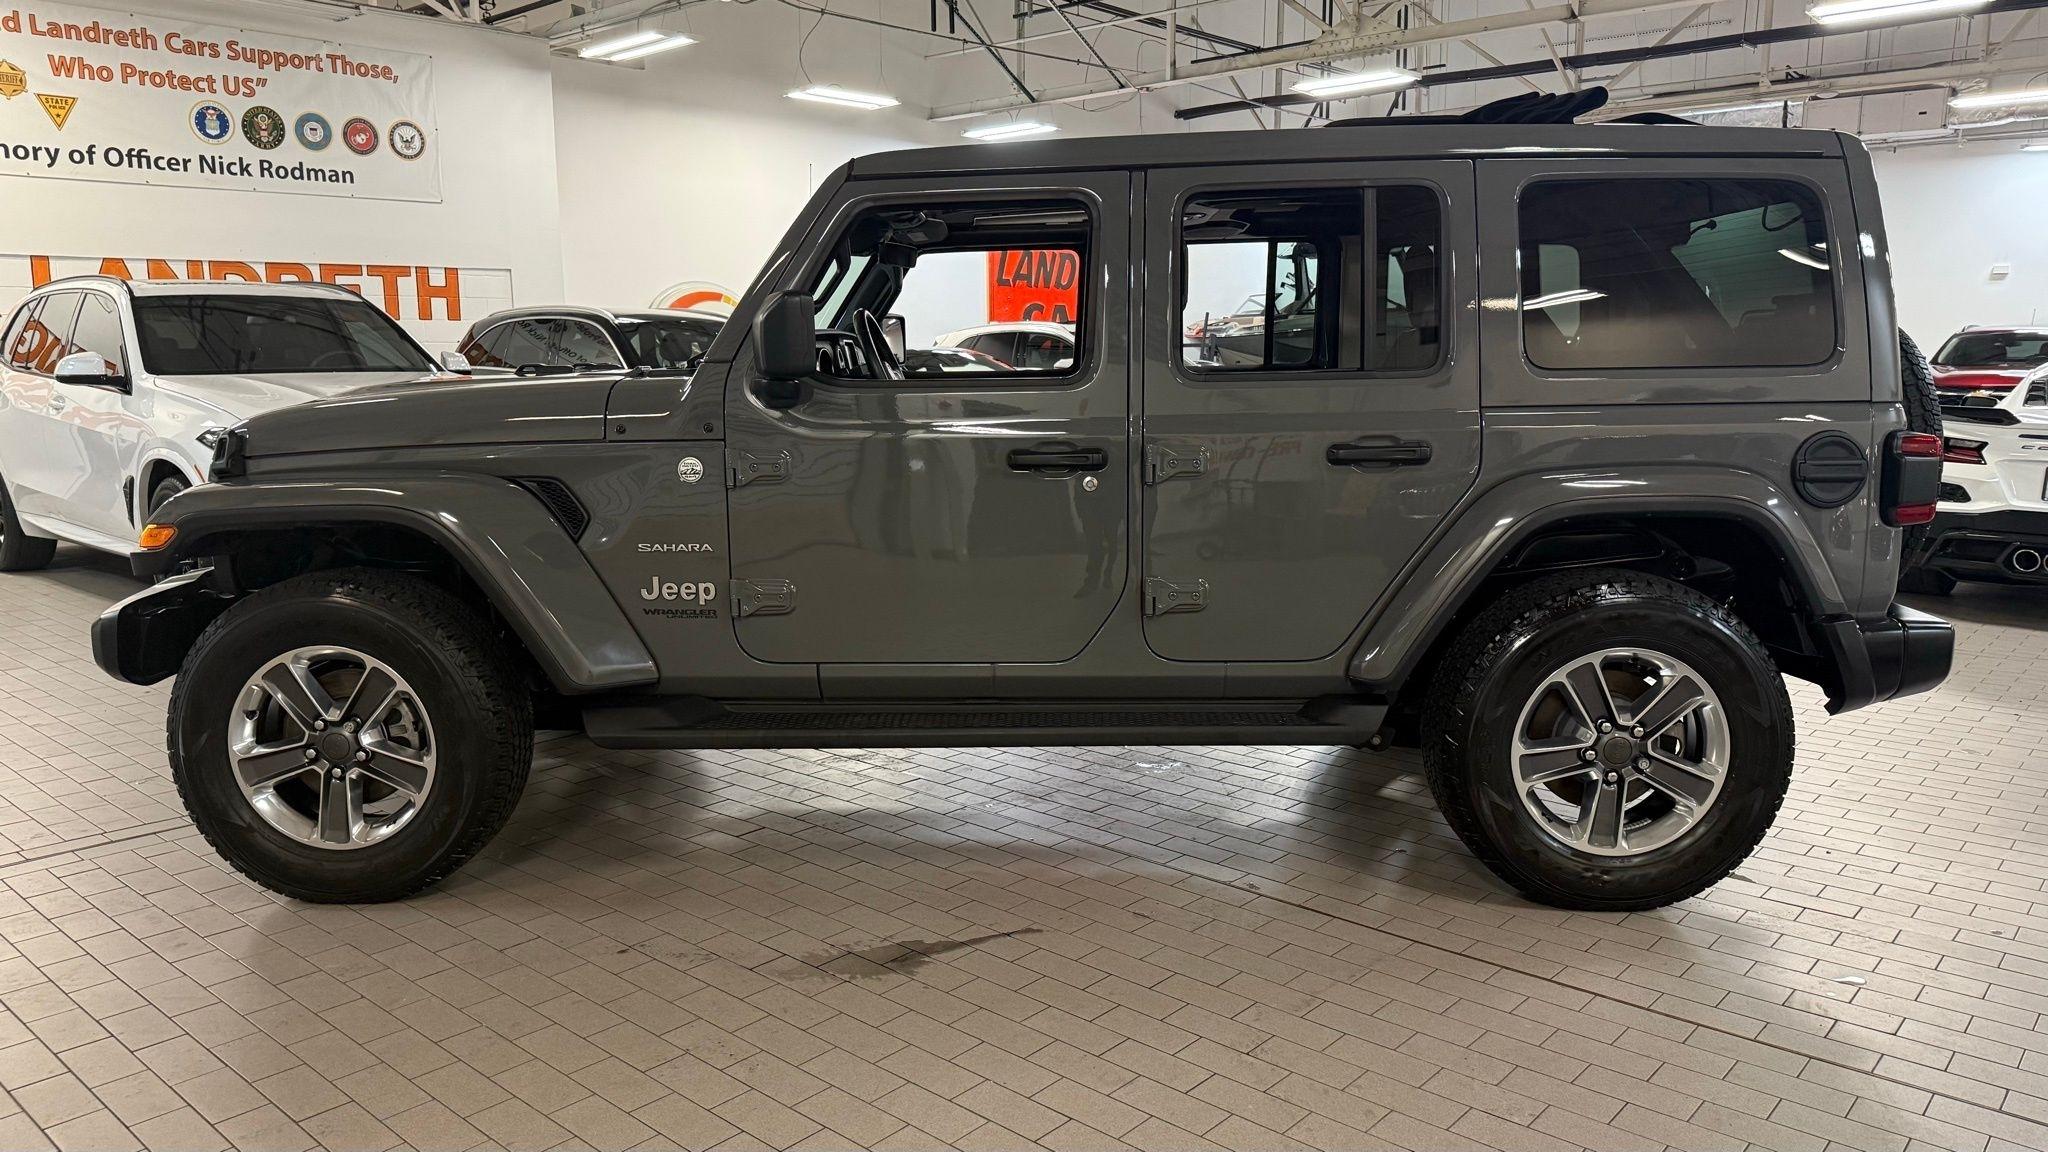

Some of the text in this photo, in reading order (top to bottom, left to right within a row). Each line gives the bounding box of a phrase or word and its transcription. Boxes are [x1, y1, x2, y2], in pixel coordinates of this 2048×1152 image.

[28, 13, 158, 51] Landreth
[164, 32, 221, 59] Cars
[225, 40, 324, 72] Support
[326, 53, 399, 84] Those,
[47, 53, 114, 83] Who
[120, 62, 217, 94] Protect
[44, 97, 70, 106] STATE
[68, 144, 96, 165] of
[103, 146, 192, 173] Officer
[198, 154, 254, 178] Nick
[259, 159, 355, 184] Rodman
[638, 543, 714, 552] SAHARA
[640, 576, 716, 606] Jeep
[643, 608, 718, 616] WRANGLER
